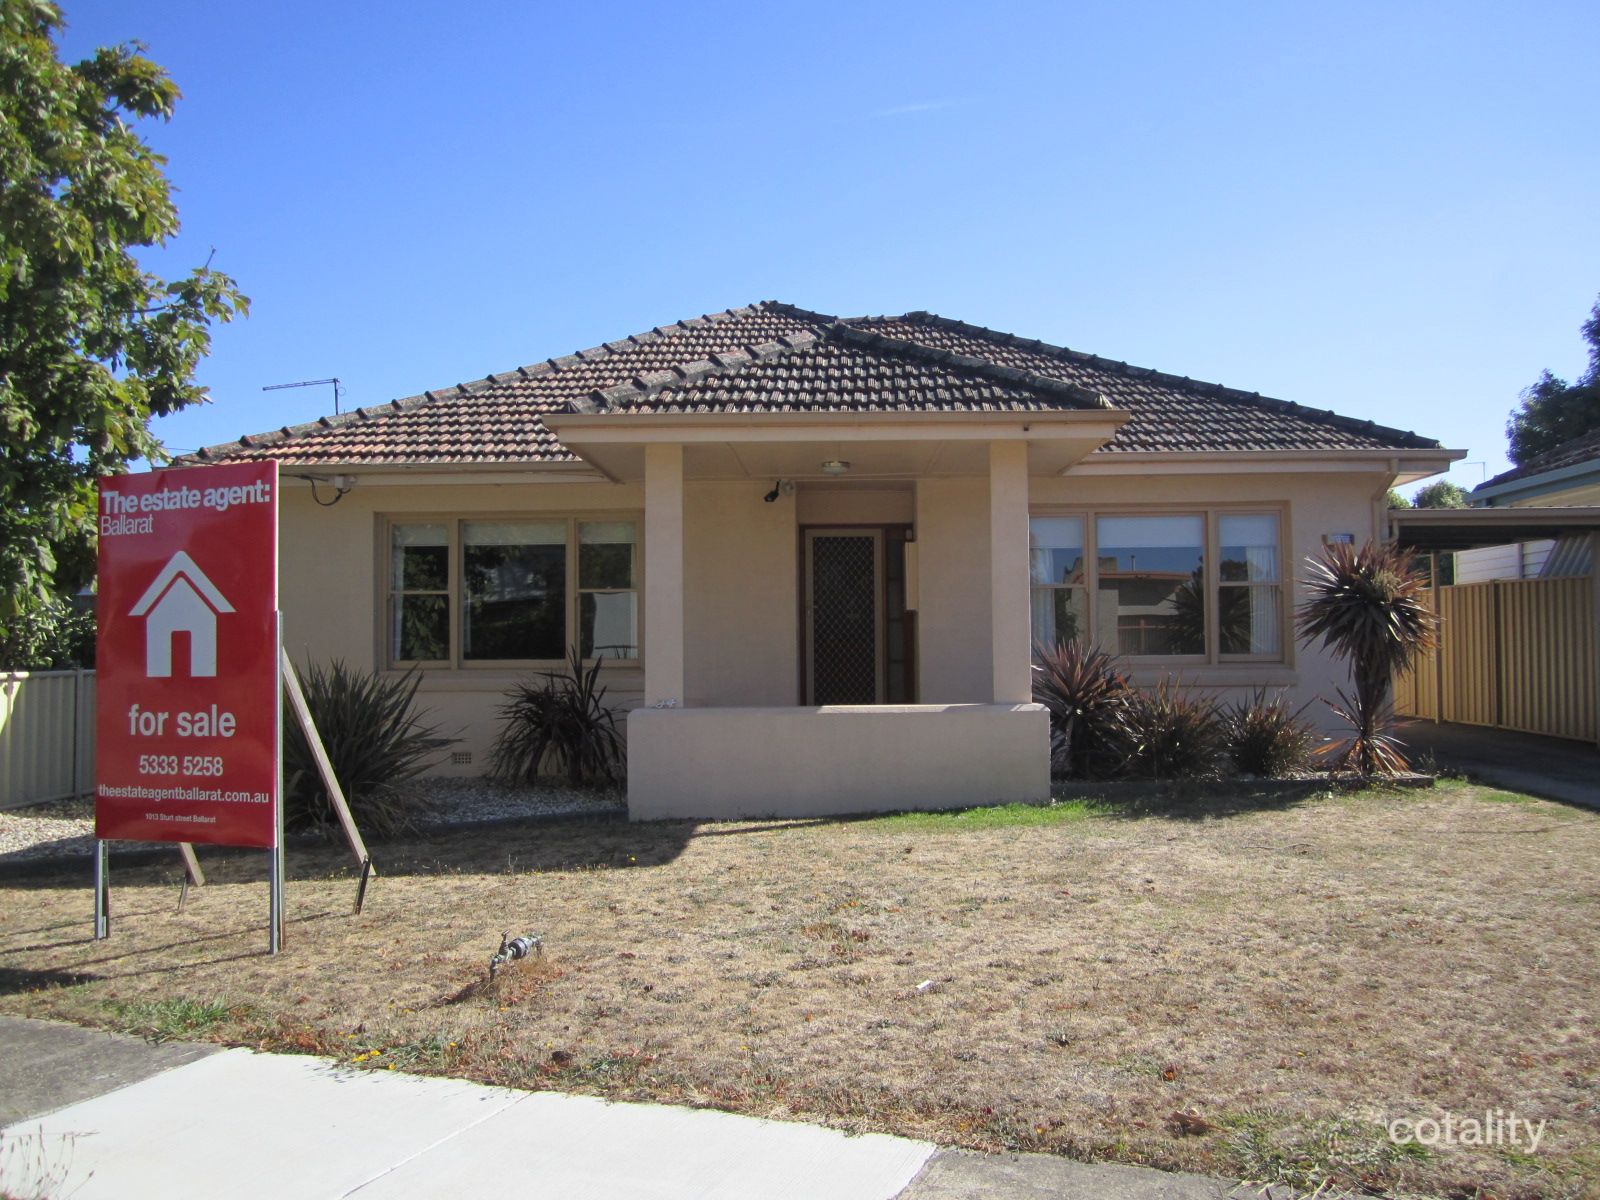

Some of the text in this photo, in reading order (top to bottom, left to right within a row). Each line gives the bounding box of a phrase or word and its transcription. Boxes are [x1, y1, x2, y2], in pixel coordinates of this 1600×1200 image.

[101, 479, 271, 515] The estate agent:
[100, 514, 153, 537] Ballarat
[128, 703, 237, 738] for sale
[138, 754, 224, 777] 5333 5258
[98, 783, 270, 804] theestateagentballarat.com.au
[193, 815, 216, 823] Ballarat
